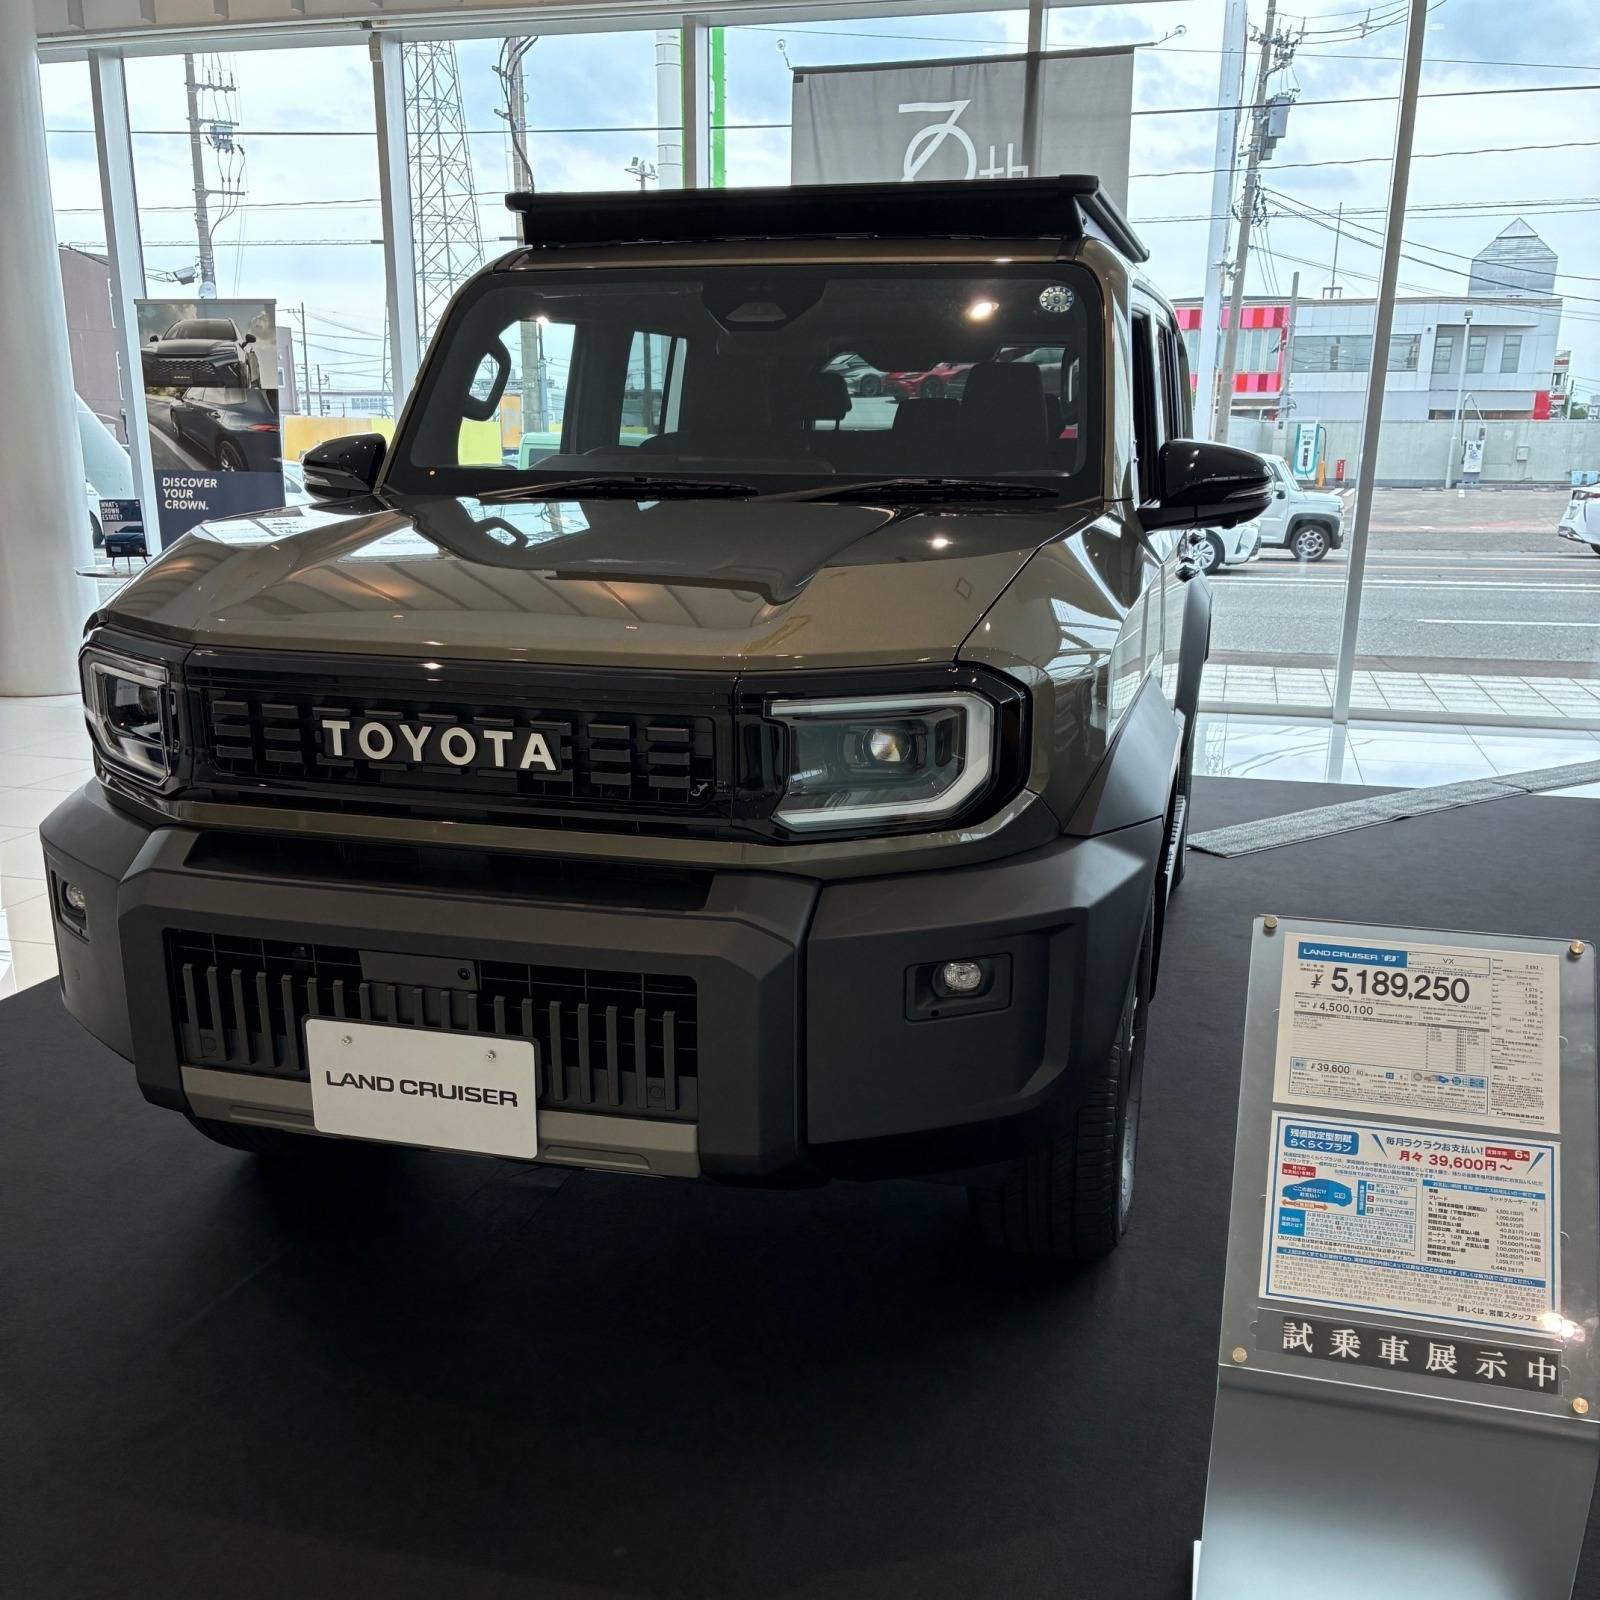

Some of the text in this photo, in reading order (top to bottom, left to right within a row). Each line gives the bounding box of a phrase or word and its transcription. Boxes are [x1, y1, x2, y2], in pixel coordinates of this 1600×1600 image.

[162, 477, 218, 488] DISCOVER
[163, 488, 194, 499] YOUR
[164, 500, 209, 510] CROWN.
[321, 719, 557, 771] TOYOTA
[1303, 948, 1331, 957] LAND
[1332, 950, 1378, 961] CRUISER
[1442, 957, 1456, 965] VX
[1331, 967, 1470, 1003] 5,189,250
[1320, 1002, 1373, 1015] 4,500,100
[325, 1070, 518, 1107] LAND CRUISER
[1290, 1139, 1352, 1151] らくらくプラン
[1386, 1136, 1484, 1155] 毎月ラクラクお支払い!
[1399, 1150, 1423, 1162] 月々
[1281, 1321, 1557, 1388] 試乗車展示中
